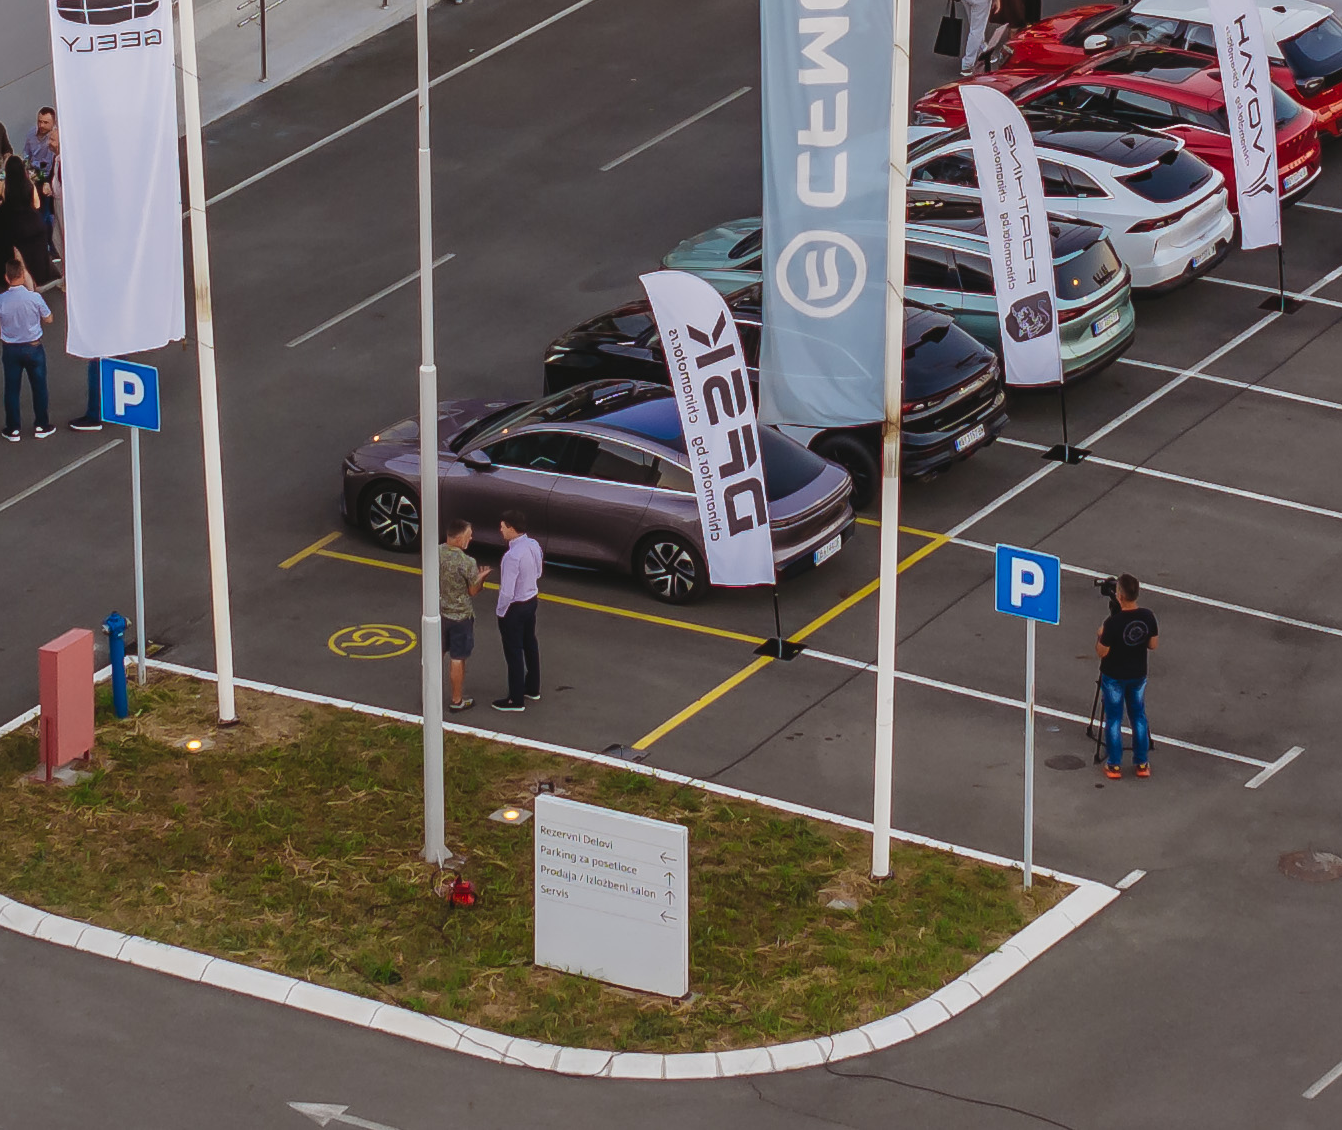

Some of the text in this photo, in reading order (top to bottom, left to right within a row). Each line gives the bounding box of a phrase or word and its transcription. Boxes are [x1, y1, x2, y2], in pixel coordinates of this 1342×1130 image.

[114, 369, 145, 416] P
[1011, 556, 1045, 607] P
[540, 825, 581, 843] Rezervni
[540, 845, 577, 864] Parking
[579, 855, 590, 865] za
[540, 864, 577, 883] Prodaja
[630, 886, 657, 899] salon
[540, 884, 570, 899] Servis
